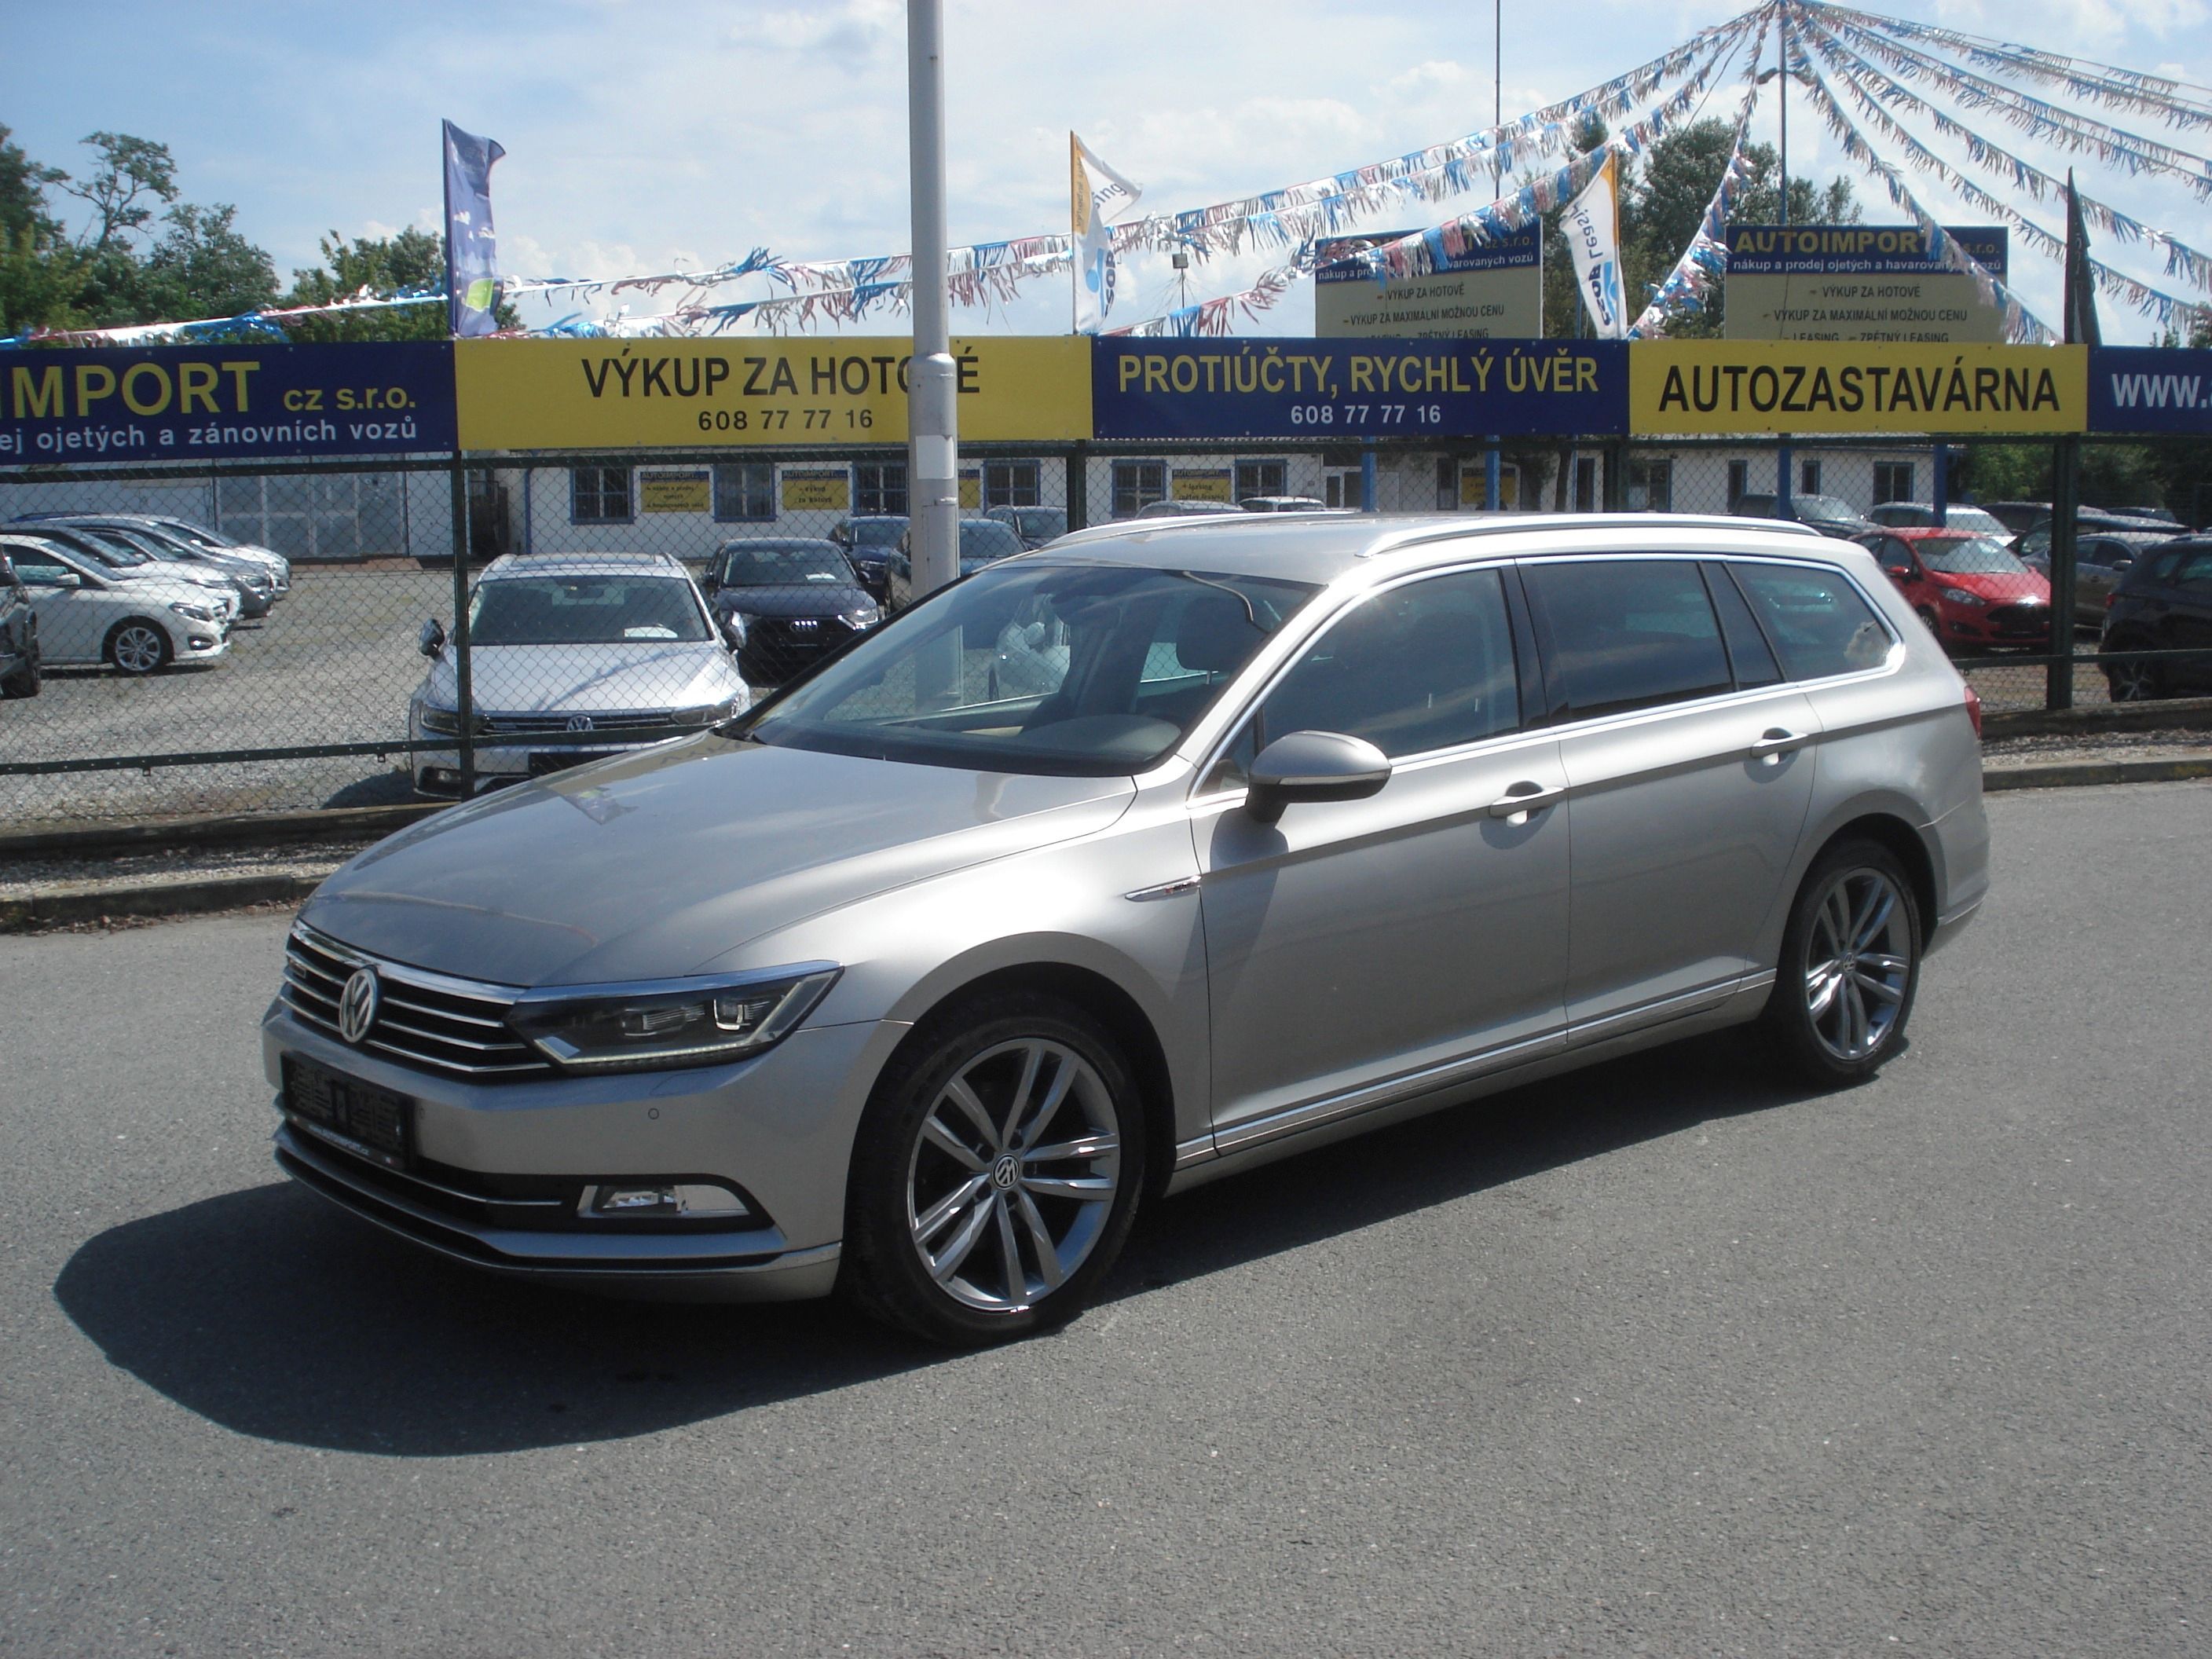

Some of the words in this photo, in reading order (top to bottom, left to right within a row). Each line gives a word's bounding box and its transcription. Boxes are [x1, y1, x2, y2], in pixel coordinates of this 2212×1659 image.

[1734, 230, 1928, 254] AUTOIMPOR
[1320, 269, 1347, 280] nákup
[1436, 255, 1505, 270] varovaných
[1734, 258, 1771, 271] nákup
[1774, 261, 1782, 269] a
[1785, 258, 1824, 272] prodej
[1828, 258, 1871, 272] ojetých
[1875, 261, 1882, 269] a
[1387, 286, 1414, 300] VÝKUP
[1416, 287, 1427, 298] ZA
[1822, 284, 1859, 298] VÝKUP
[1861, 286, 1875, 298] ZA
[1350, 312, 1378, 326] VÝKUP
[1379, 313, 1391, 324] ZA
[1480, 304, 1504, 316] CENU
[1774, 307, 1811, 321] VÝKUP
[1812, 309, 1827, 321] ZA
[1830, 307, 1888, 321] MAXIMÁLNÍ
[1890, 307, 1936, 321] MOŽNOU
[1938, 309, 1967, 321] CENU
[581, 349, 730, 397] VÝKUP
[743, 357, 799, 397] ZA
[811, 346, 980, 395] HOTÉ
[1119, 347, 1338, 398] PROTIÚČTY,
[1350, 348, 1495, 392] RYCHLÝ
[1505, 347, 1599, 392] ÚVĚR
[0, 361, 260, 419] MPORT
[284, 389, 324, 412] cz
[337, 387, 416, 410] s.r.o.
[1658, 356, 2060, 412] AUTOZASTAVÁRNA
[698, 410, 748, 431] 608
[760, 410, 789, 430] 77
[803, 410, 831, 430] 77
[846, 409, 873, 429] 16
[1291, 405, 1334, 424] 608
[1344, 405, 1369, 424] 77
[1380, 405, 1405, 423] 77
[1417, 405, 1441, 423] 16
[37, 424, 145, 452] ojetých
[159, 429, 174, 445] a
[189, 419, 336, 445] zánovních
[350, 416, 416, 440] vozů
